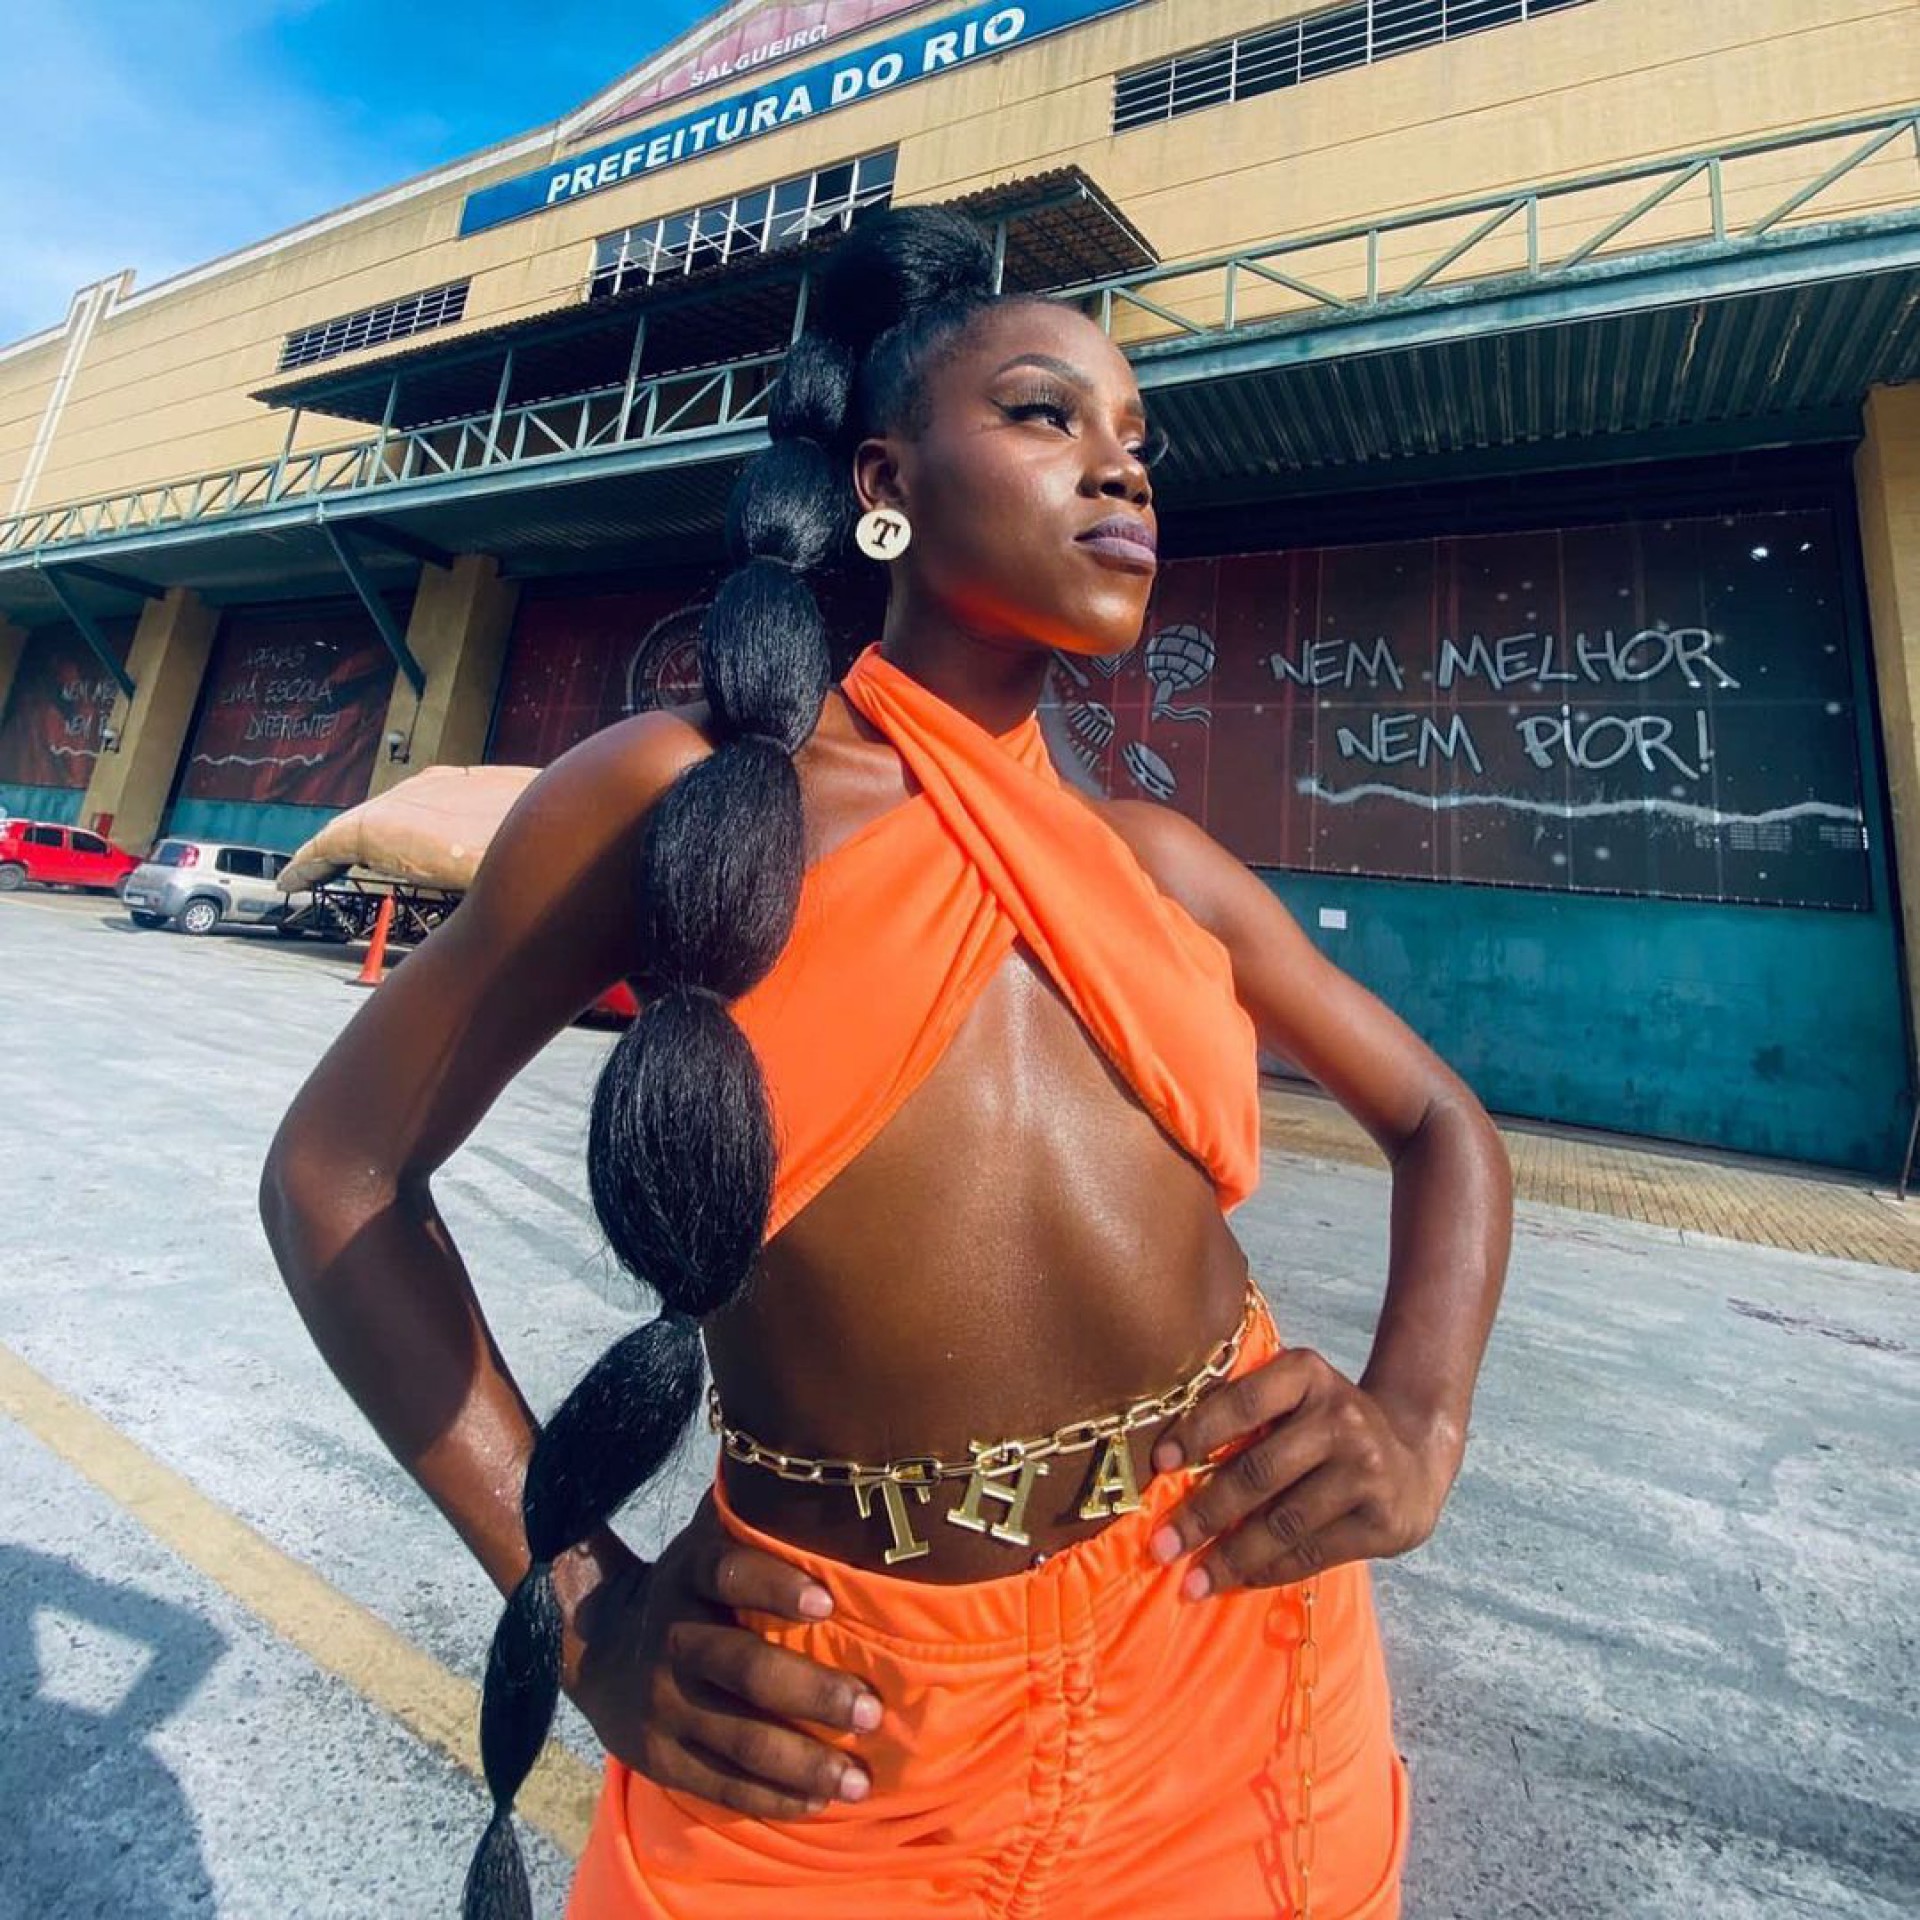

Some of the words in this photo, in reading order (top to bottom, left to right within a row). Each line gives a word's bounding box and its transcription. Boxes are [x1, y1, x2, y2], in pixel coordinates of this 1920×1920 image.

[690, 25, 828, 87] SALGUEIRO
[546, 85, 813, 204] PREFEITURA
[831, 53, 904, 104] DO
[923, 7, 1035, 72] RIO
[873, 516, 902, 550] T
[1270, 637, 1404, 691] NEM
[1438, 628, 1742, 691] MELHOR
[1336, 712, 1483, 774] NEM
